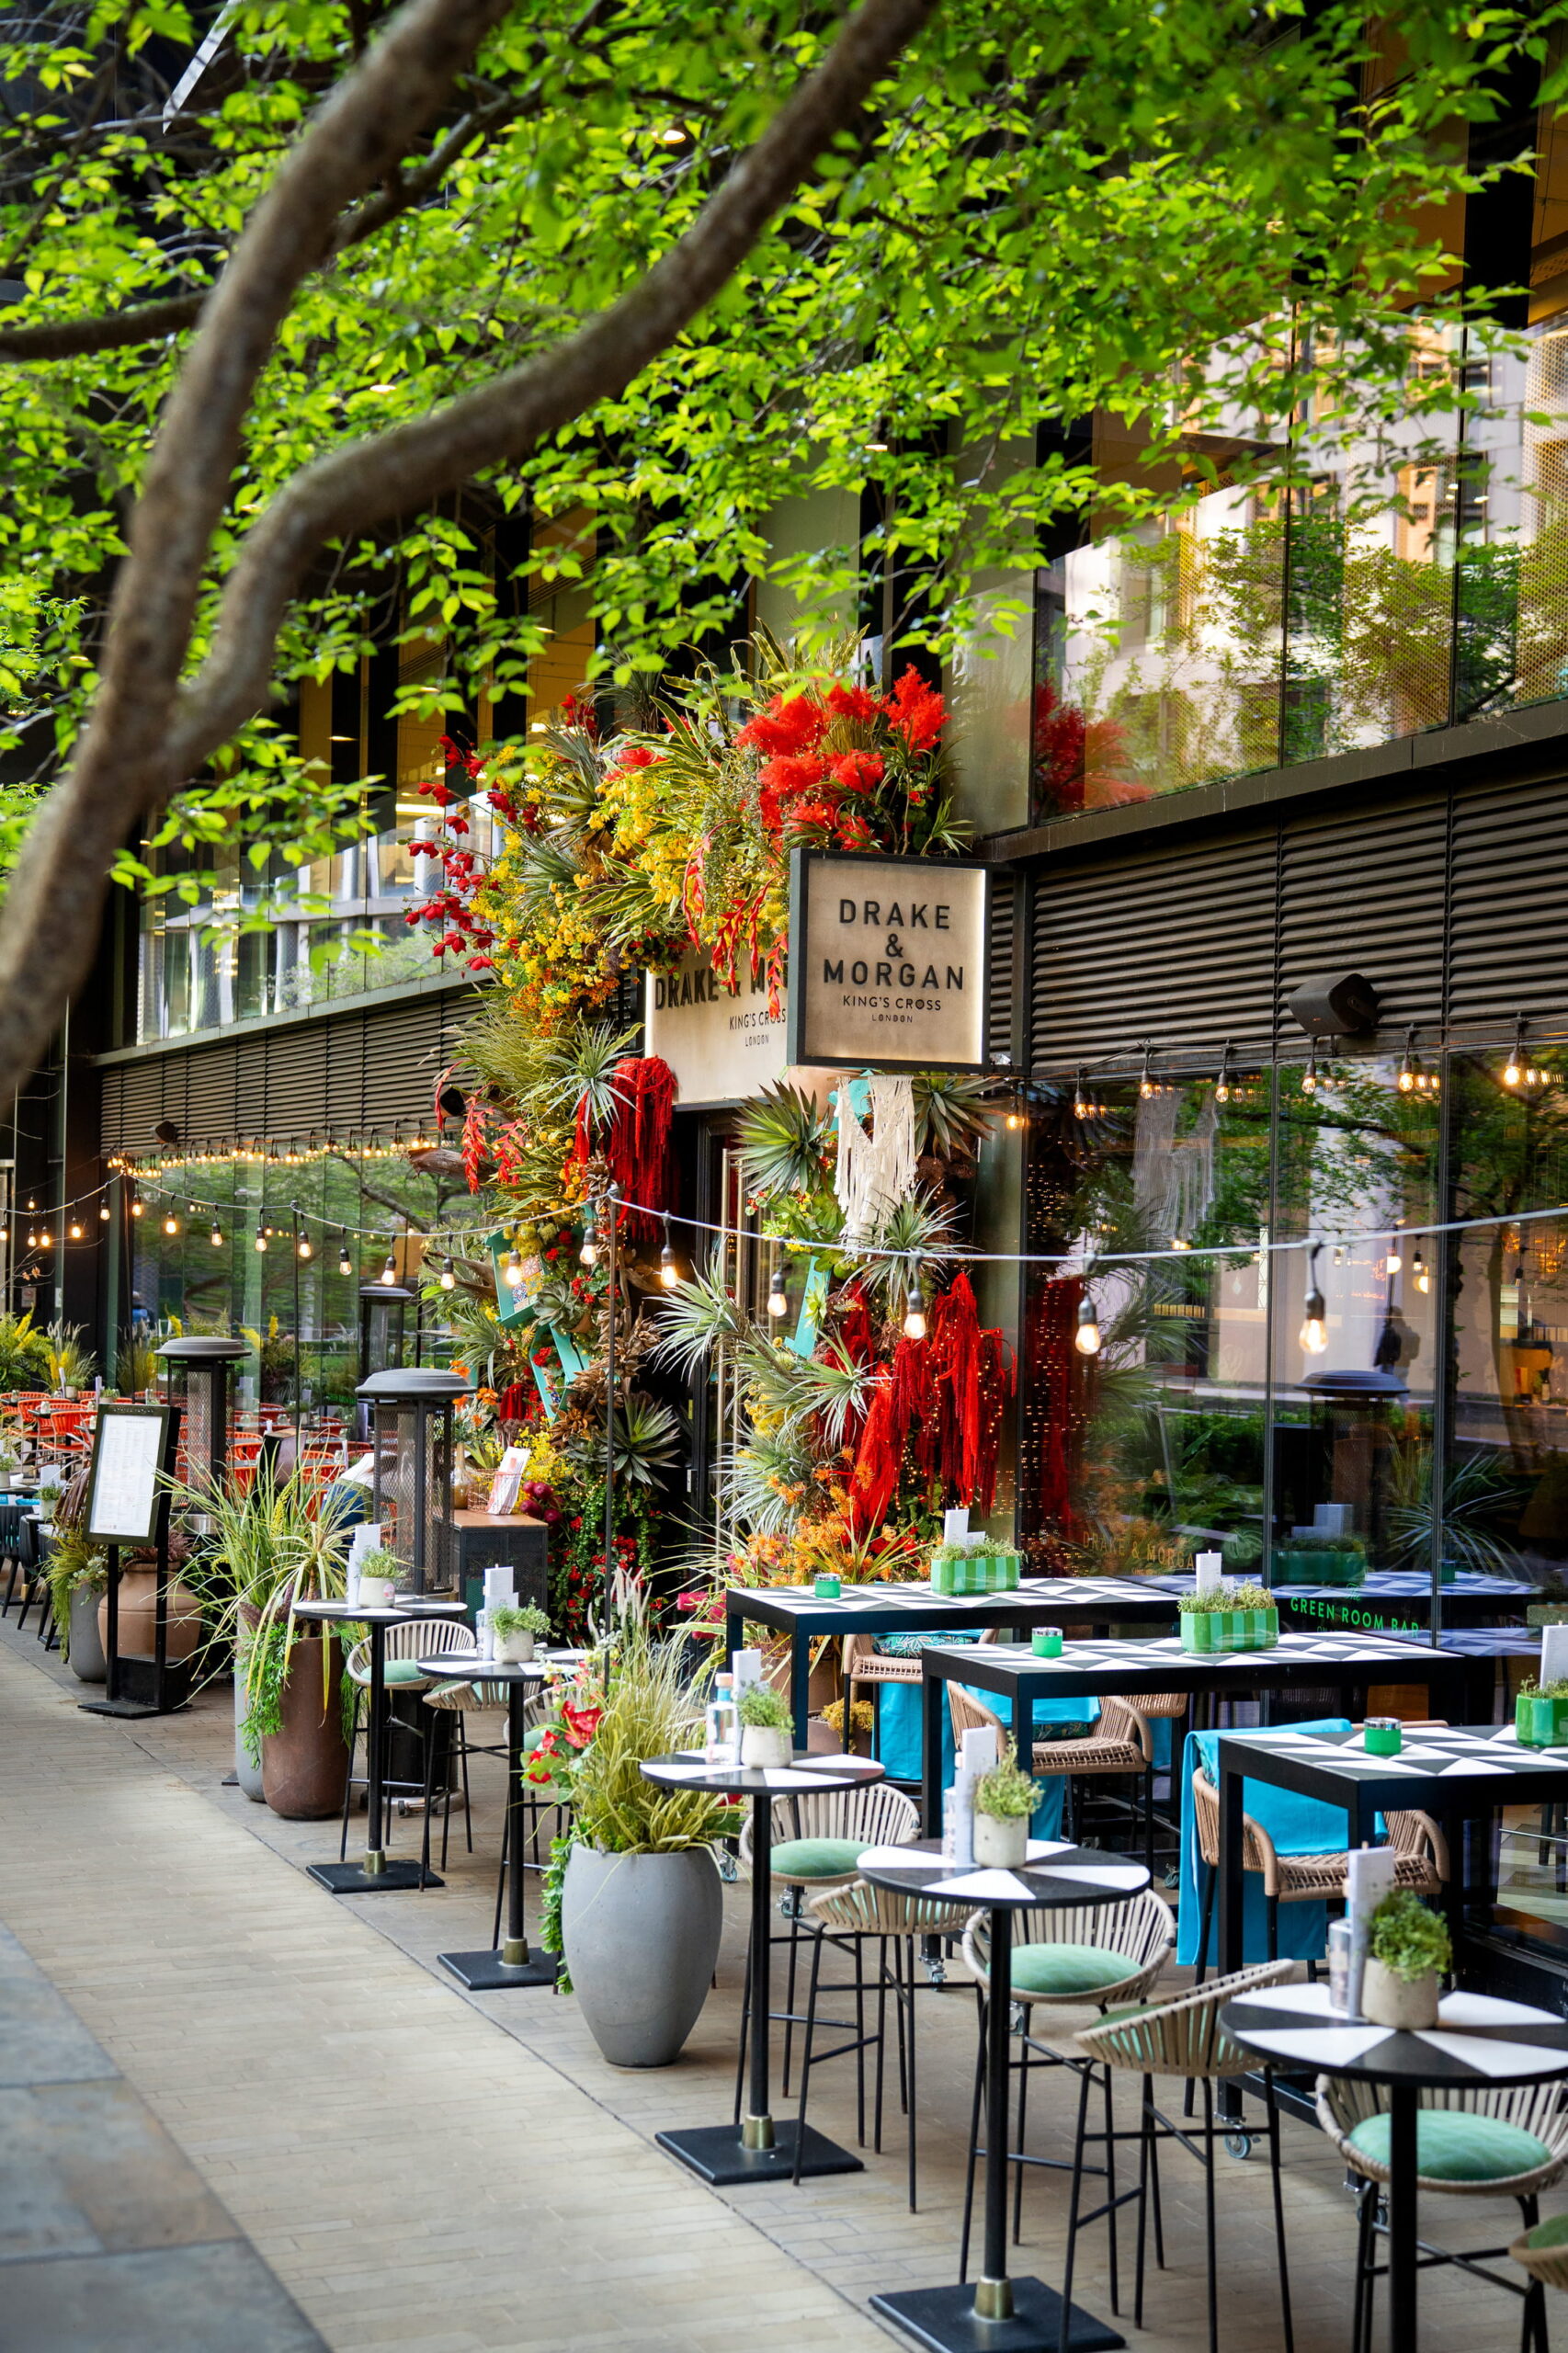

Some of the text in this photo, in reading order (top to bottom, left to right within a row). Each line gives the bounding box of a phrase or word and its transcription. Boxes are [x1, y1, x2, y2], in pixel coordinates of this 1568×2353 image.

[839, 899, 949, 929] DRAKE
[885, 933, 903, 958] &
[824, 959, 963, 990] MORGAN
[655, 968, 719, 1010] DRAKE
[843, 995, 941, 1011] KING'S CROSS
[729, 1012, 756, 1030] KING'S
[871, 1014, 913, 1023] LONDON
[744, 1034, 769, 1047] LONDON
[1083, 1530, 1196, 1571] DRAKE & MORGA
[1290, 1597, 1419, 1638] GREEN ROOM BAR
